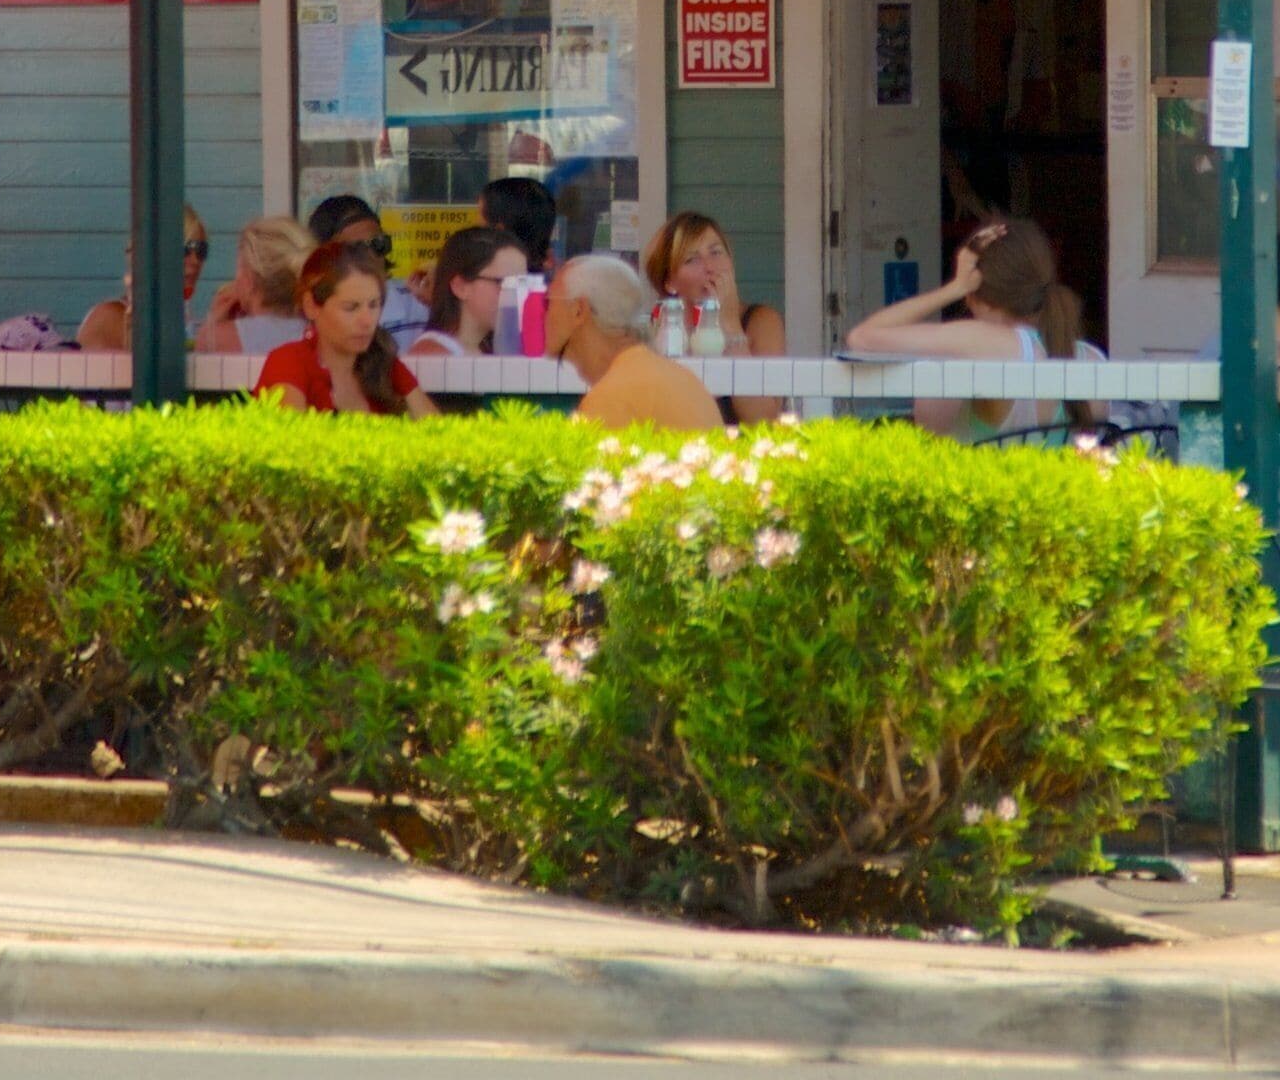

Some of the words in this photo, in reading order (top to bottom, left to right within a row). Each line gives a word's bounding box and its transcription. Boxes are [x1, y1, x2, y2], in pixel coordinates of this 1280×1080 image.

[685, 12, 766, 33] INSIDE
[686, 41, 766, 70] FIRST
[402, 211, 437, 224] ORDER
[415, 230, 441, 241] FIND
